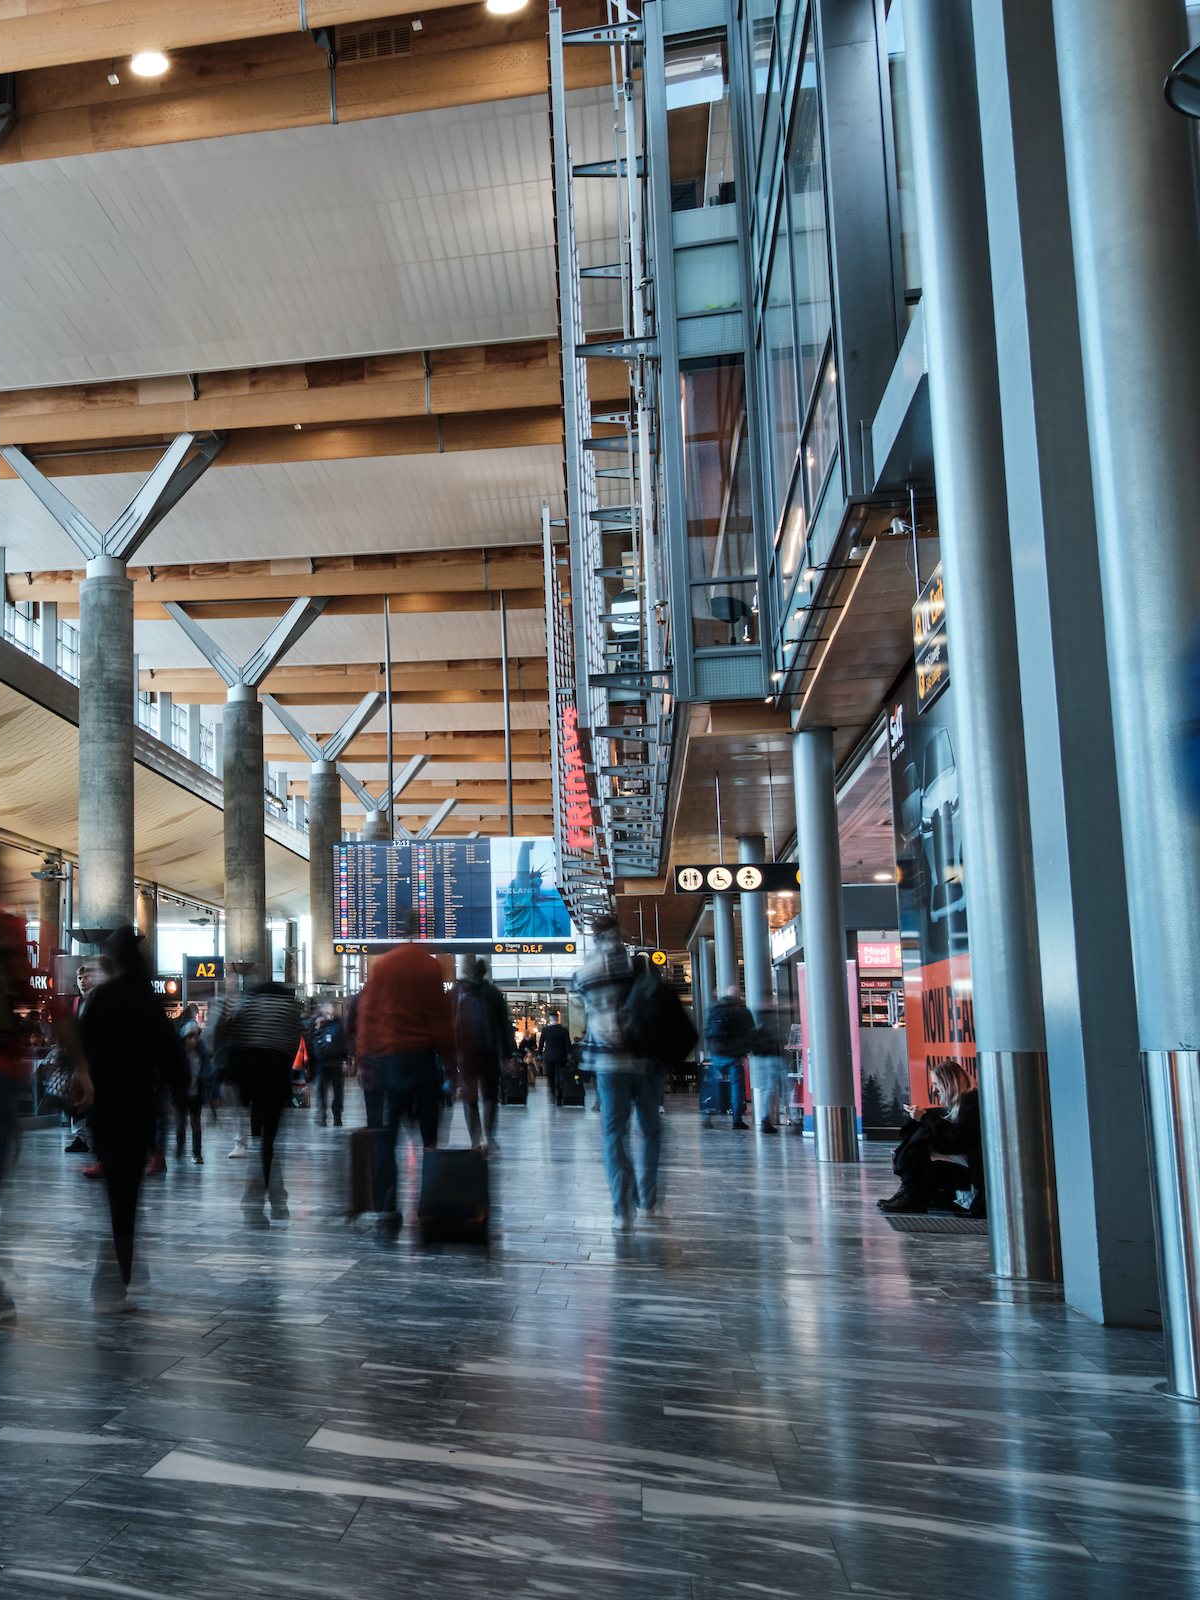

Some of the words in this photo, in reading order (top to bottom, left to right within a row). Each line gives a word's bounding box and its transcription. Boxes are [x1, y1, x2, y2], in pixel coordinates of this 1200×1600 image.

[864, 946, 890, 955] Meal
[864, 955, 890, 964] Deal
[196, 963, 216, 977] A2
[922, 987, 945, 1043] NOW
